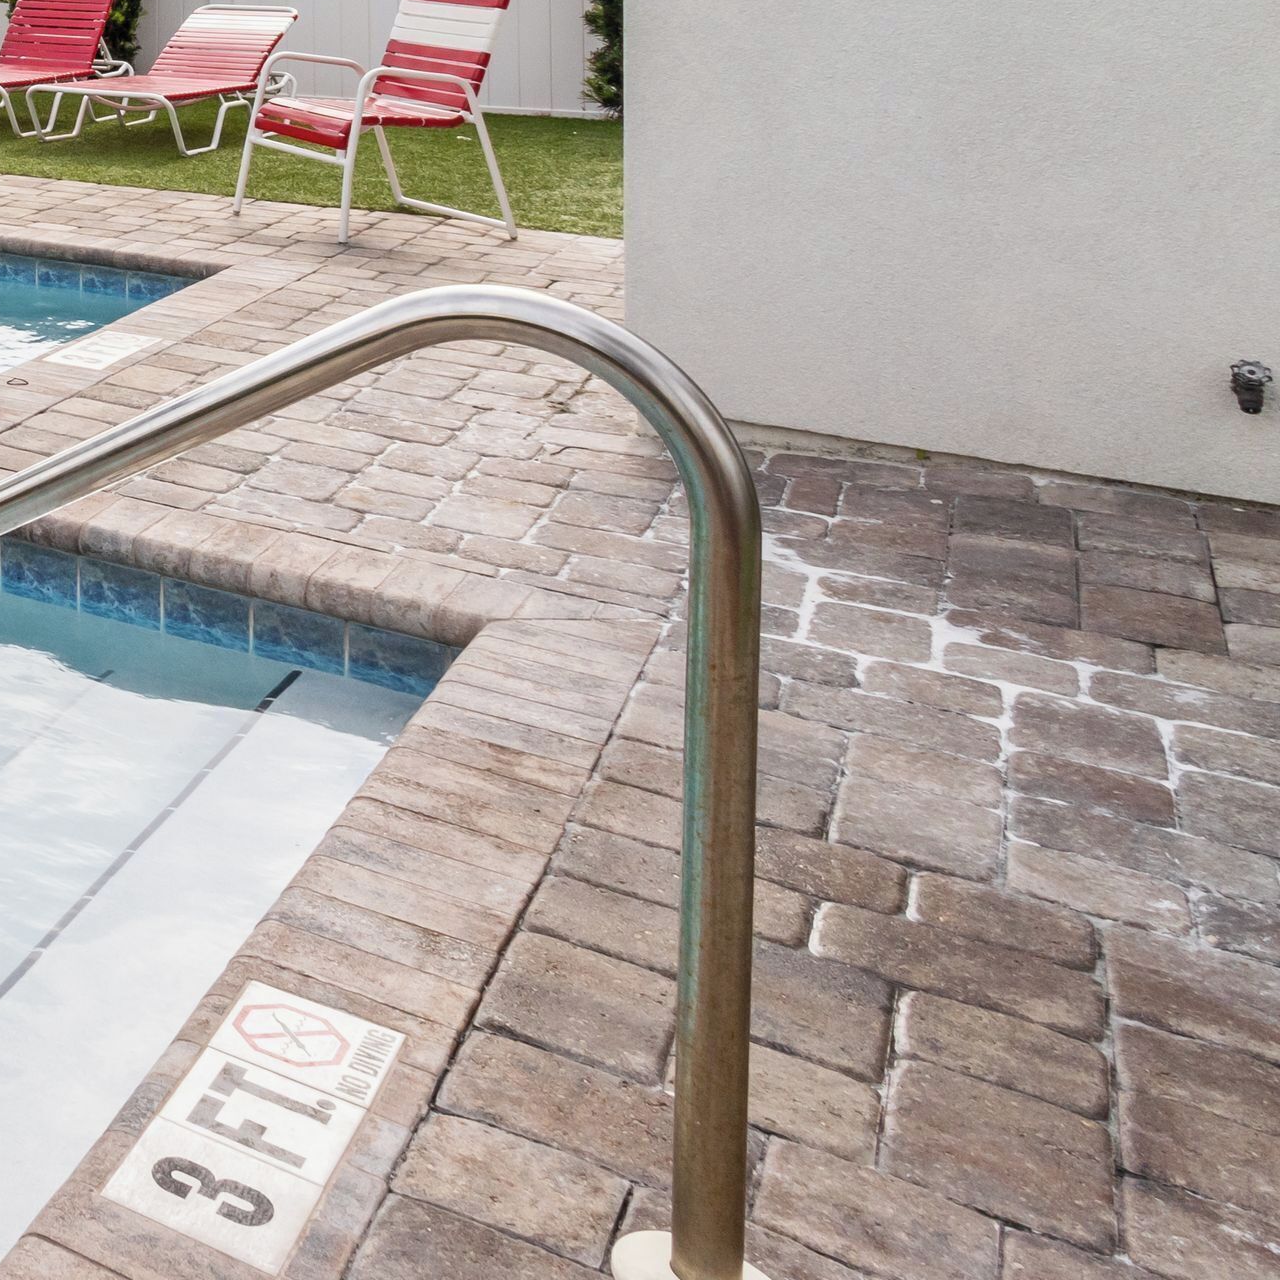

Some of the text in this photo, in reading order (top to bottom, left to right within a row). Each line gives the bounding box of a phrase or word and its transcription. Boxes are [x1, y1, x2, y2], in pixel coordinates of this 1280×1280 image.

[335, 1029, 398, 1101] NO DIVING
[151, 1156, 275, 1227] 3
